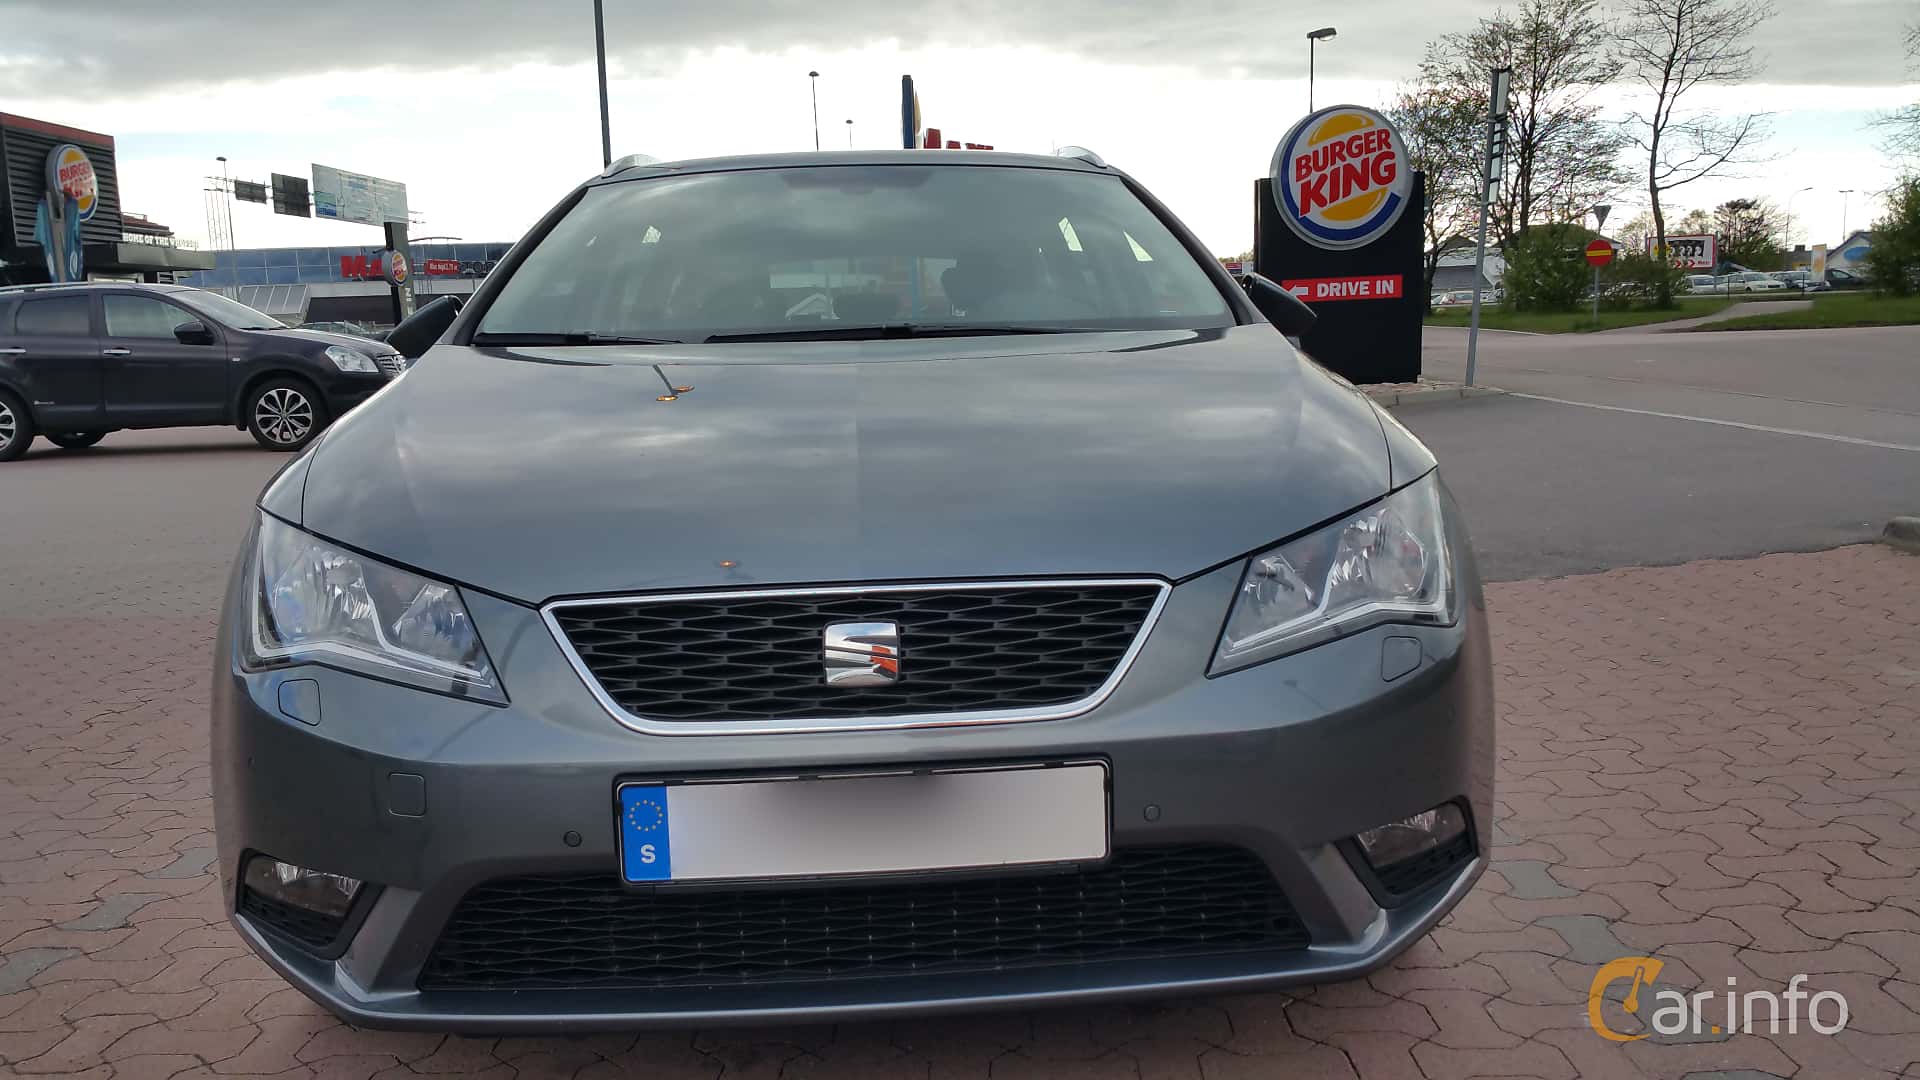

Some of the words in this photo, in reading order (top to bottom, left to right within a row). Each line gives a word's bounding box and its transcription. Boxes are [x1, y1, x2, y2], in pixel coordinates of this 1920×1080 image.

[1295, 128, 1392, 183] BURGER
[1300, 151, 1396, 217] KING
[1316, 281, 1370, 298] DRIVE
[1375, 279, 1395, 295] IN
[640, 844, 656, 864] S
